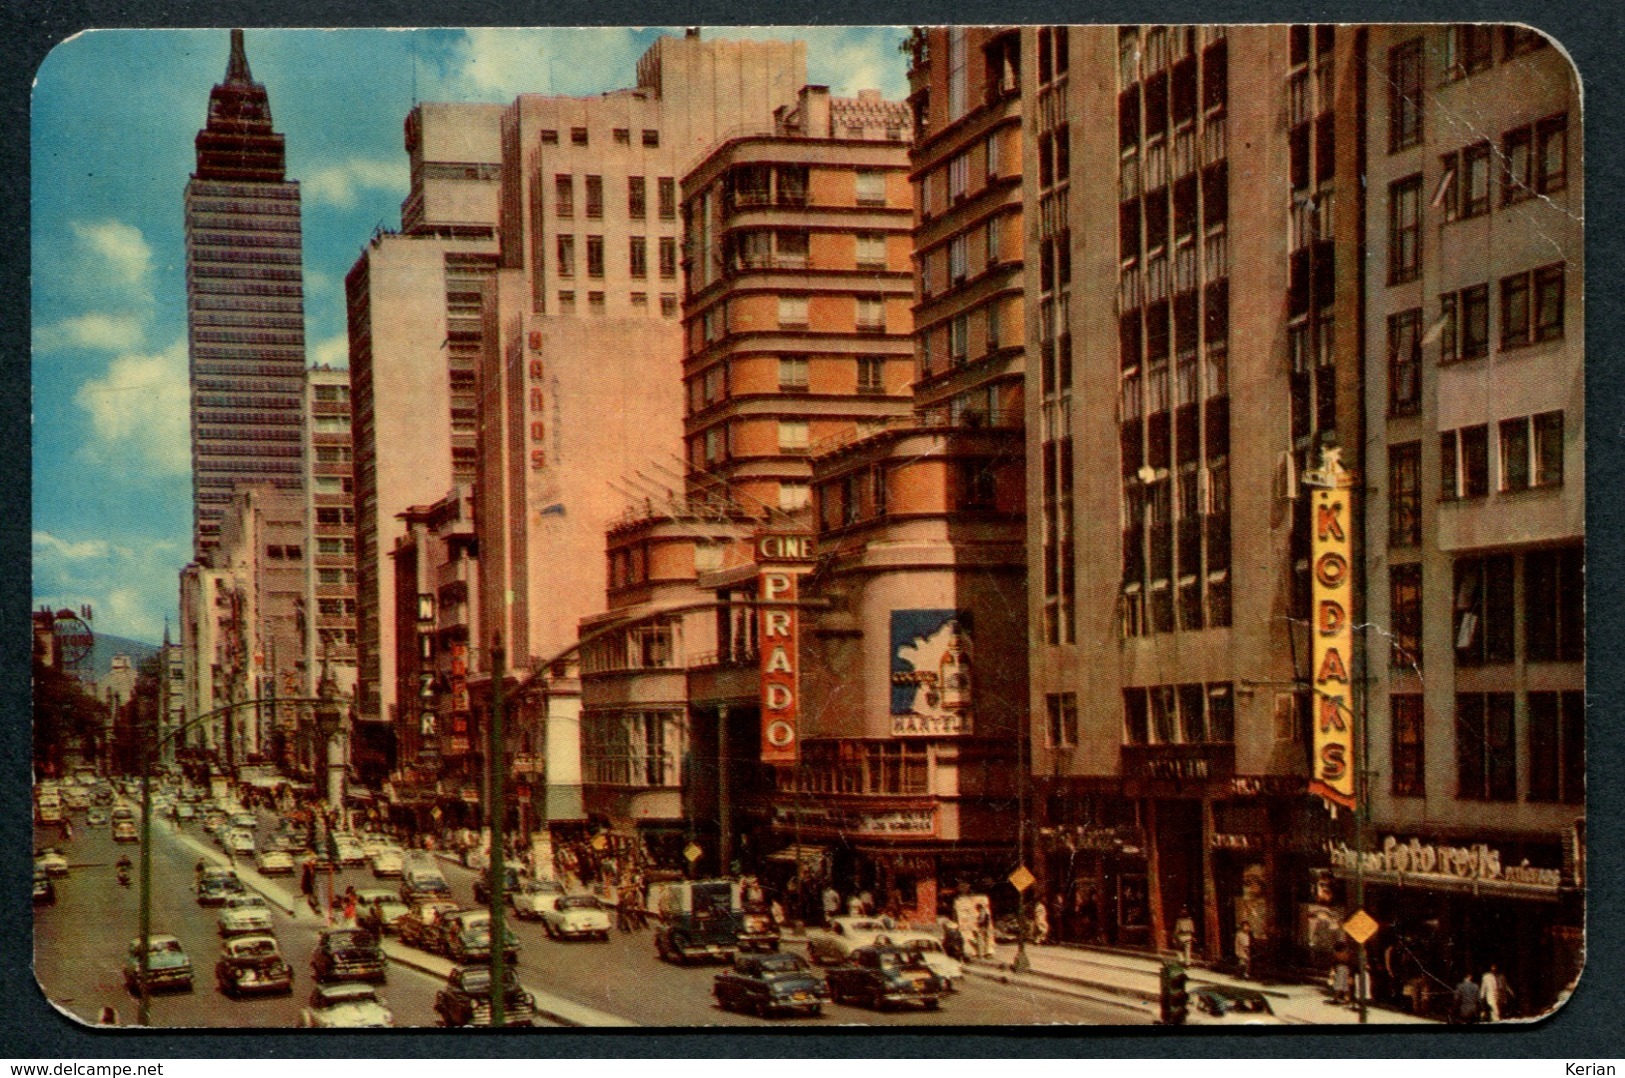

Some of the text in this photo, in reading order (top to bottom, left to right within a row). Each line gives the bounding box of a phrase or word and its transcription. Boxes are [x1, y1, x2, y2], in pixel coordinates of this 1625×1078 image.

[759, 536, 813, 559] CINE
[764, 574, 796, 748] PRADO
[1315, 503, 1349, 782] KODAKS
